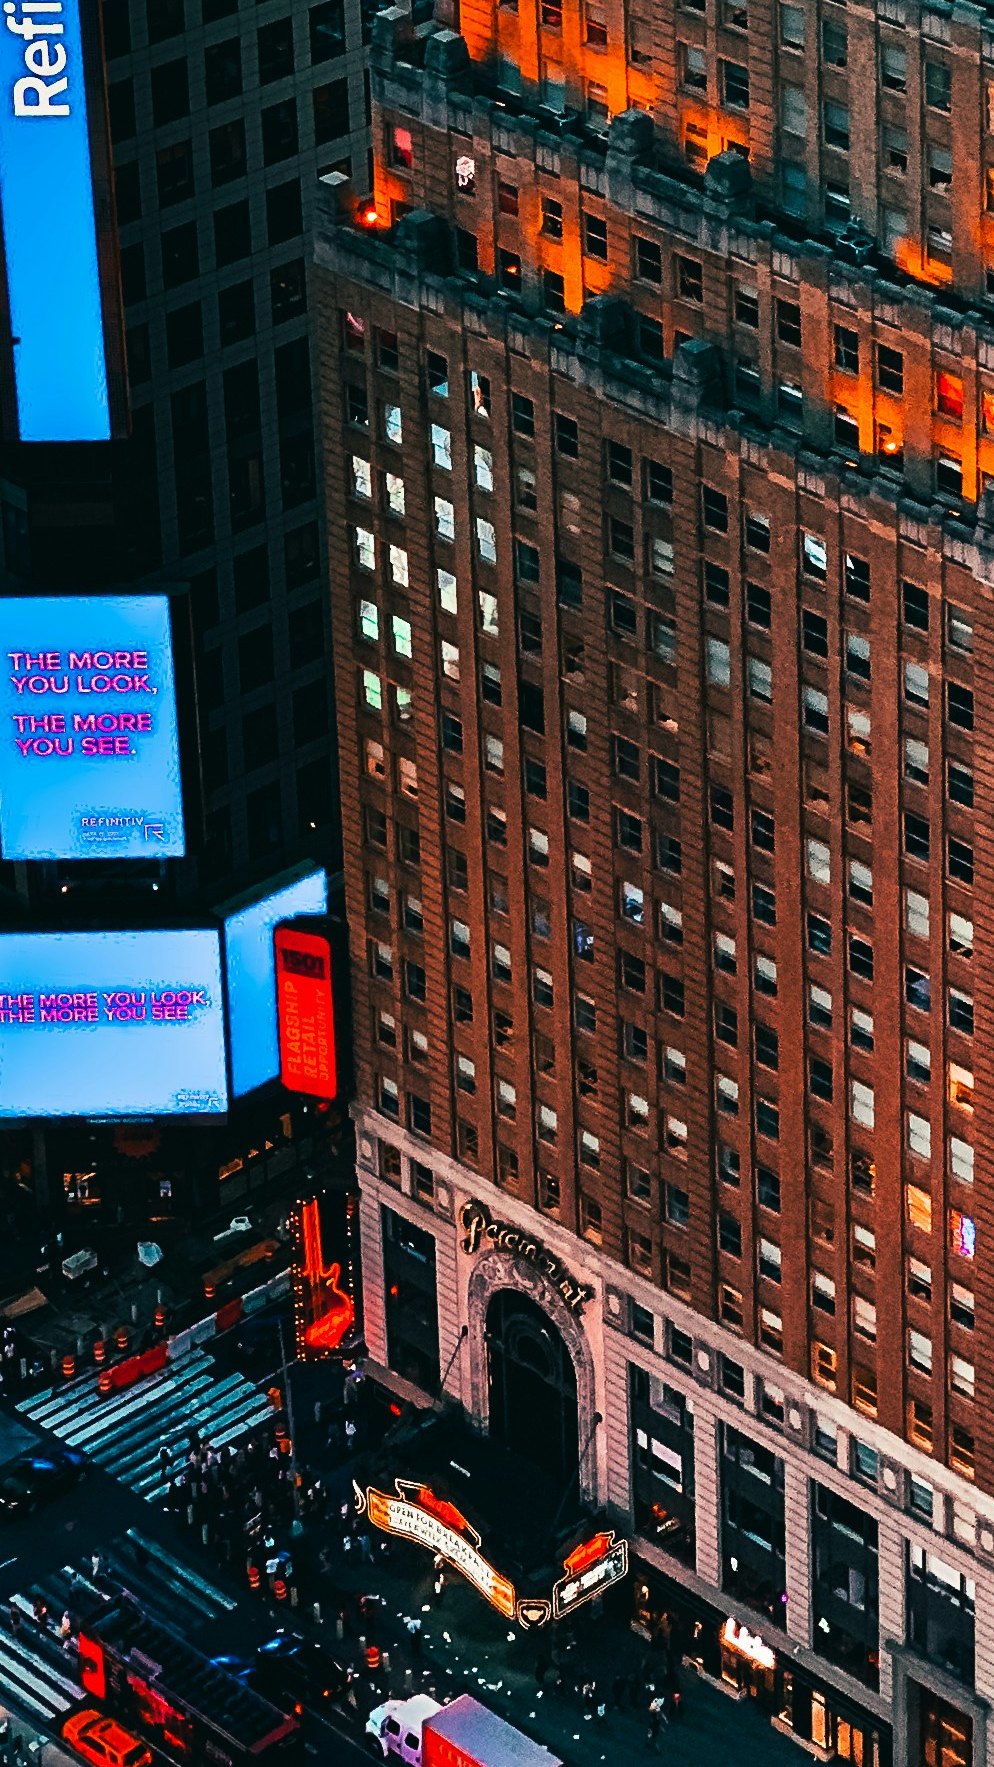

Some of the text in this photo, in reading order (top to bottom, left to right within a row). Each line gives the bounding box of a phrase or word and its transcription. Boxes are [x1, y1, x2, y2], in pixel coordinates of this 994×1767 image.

[7, 650, 148, 671] THE MORE
[10, 674, 158, 695] YOU LOOK,
[13, 713, 152, 734] THE MORE
[15, 736, 137, 756] YOU SEE.
[81, 817, 144, 827] REFINITIV
[0, 990, 211, 1009] THE MORE YOU LOOK,
[0, 1005, 193, 1023] THE MORE YOU SEE.
[284, 981, 301, 1074] FLAGSHIP
[316, 988, 330, 1081] OPPORTUNITY
[302, 1015, 318, 1079] RETAIL
